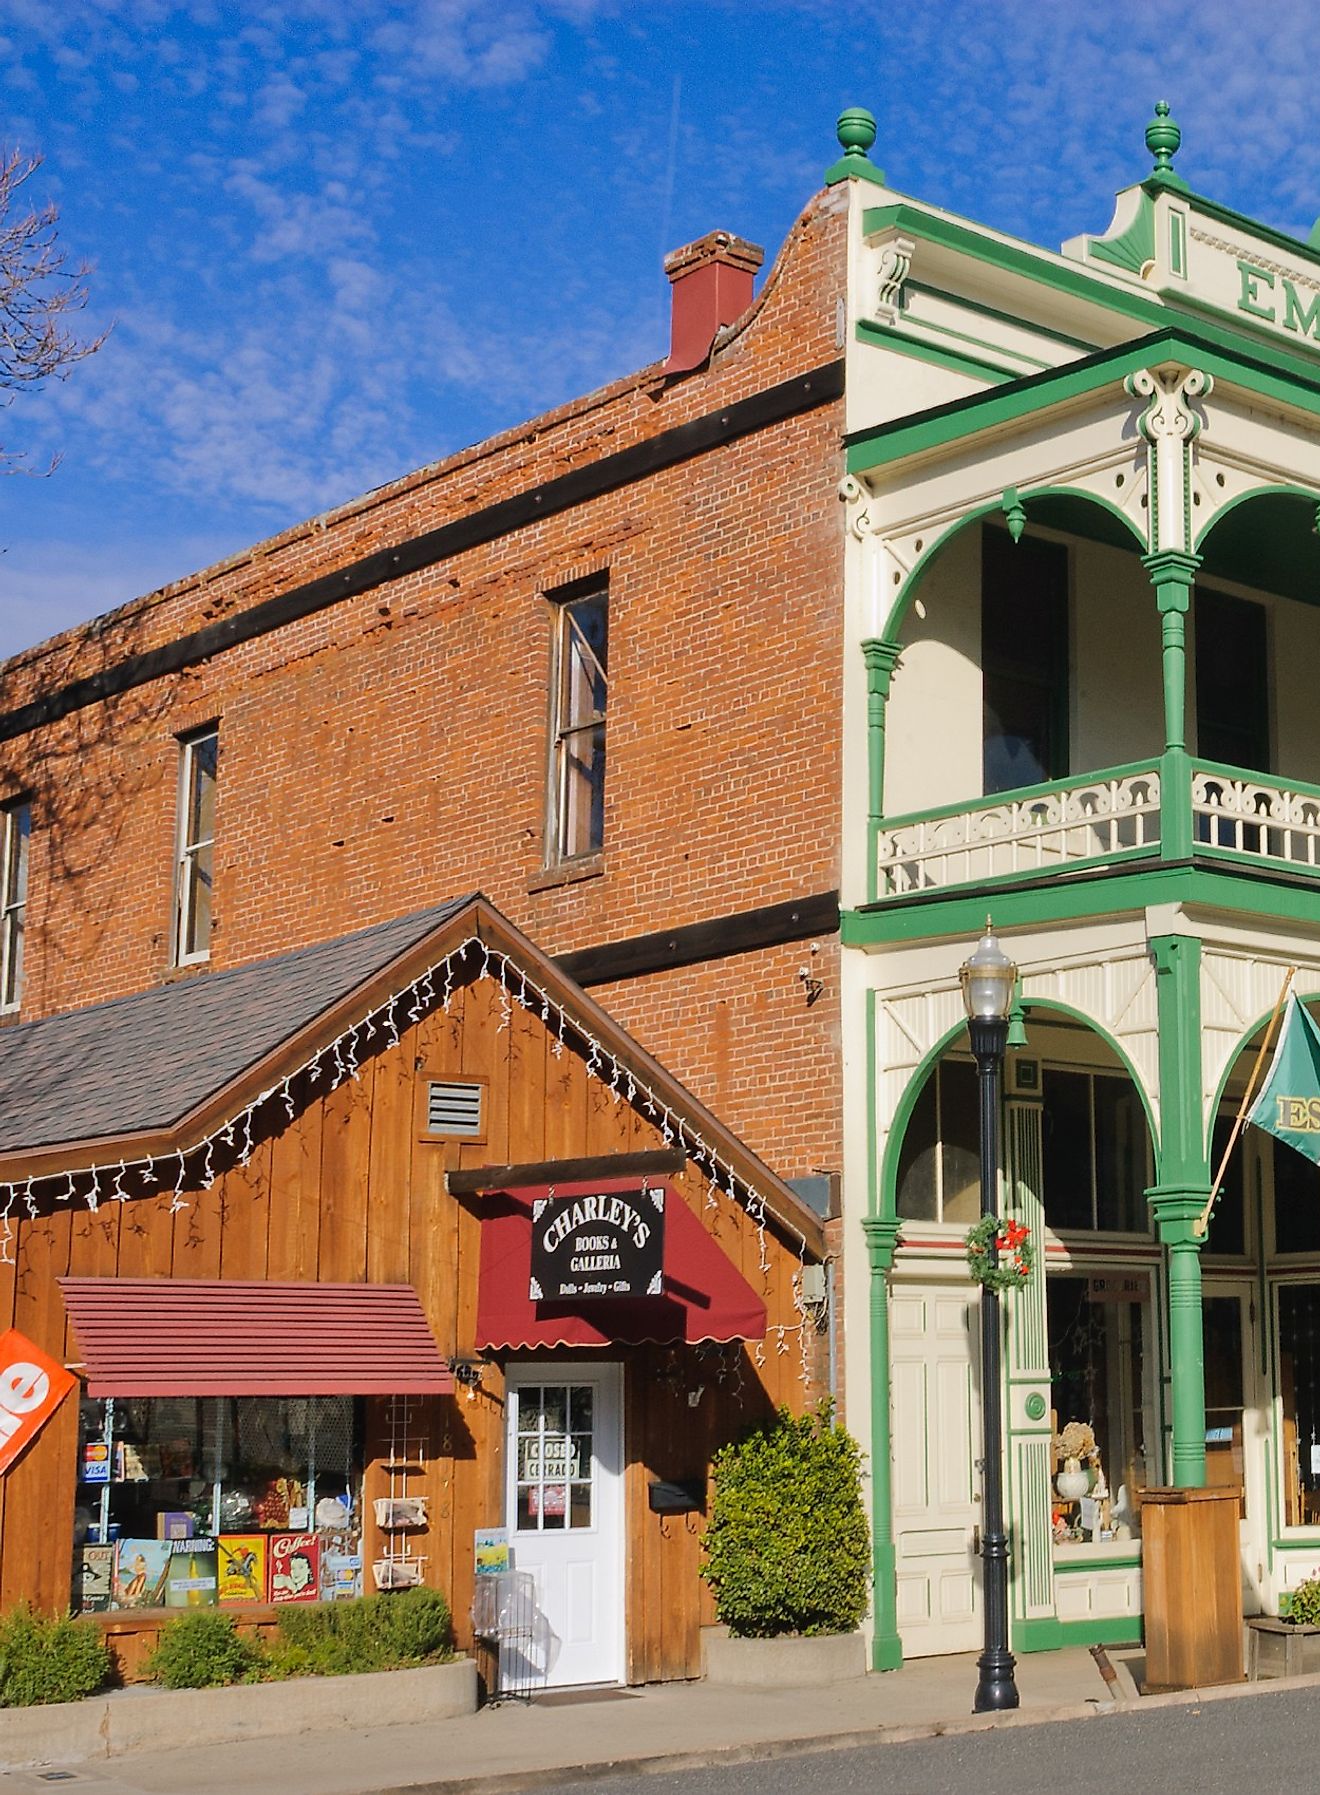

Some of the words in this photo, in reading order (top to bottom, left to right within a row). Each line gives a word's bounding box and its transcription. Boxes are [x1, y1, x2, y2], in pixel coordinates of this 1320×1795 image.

[543, 1195, 651, 1253] CHARLEY'S
[575, 1236, 609, 1252] BOOKS
[611, 1237, 618, 1250] &
[570, 1254, 621, 1272] GALLERIA
[85, 1466, 107, 1476] VISA
